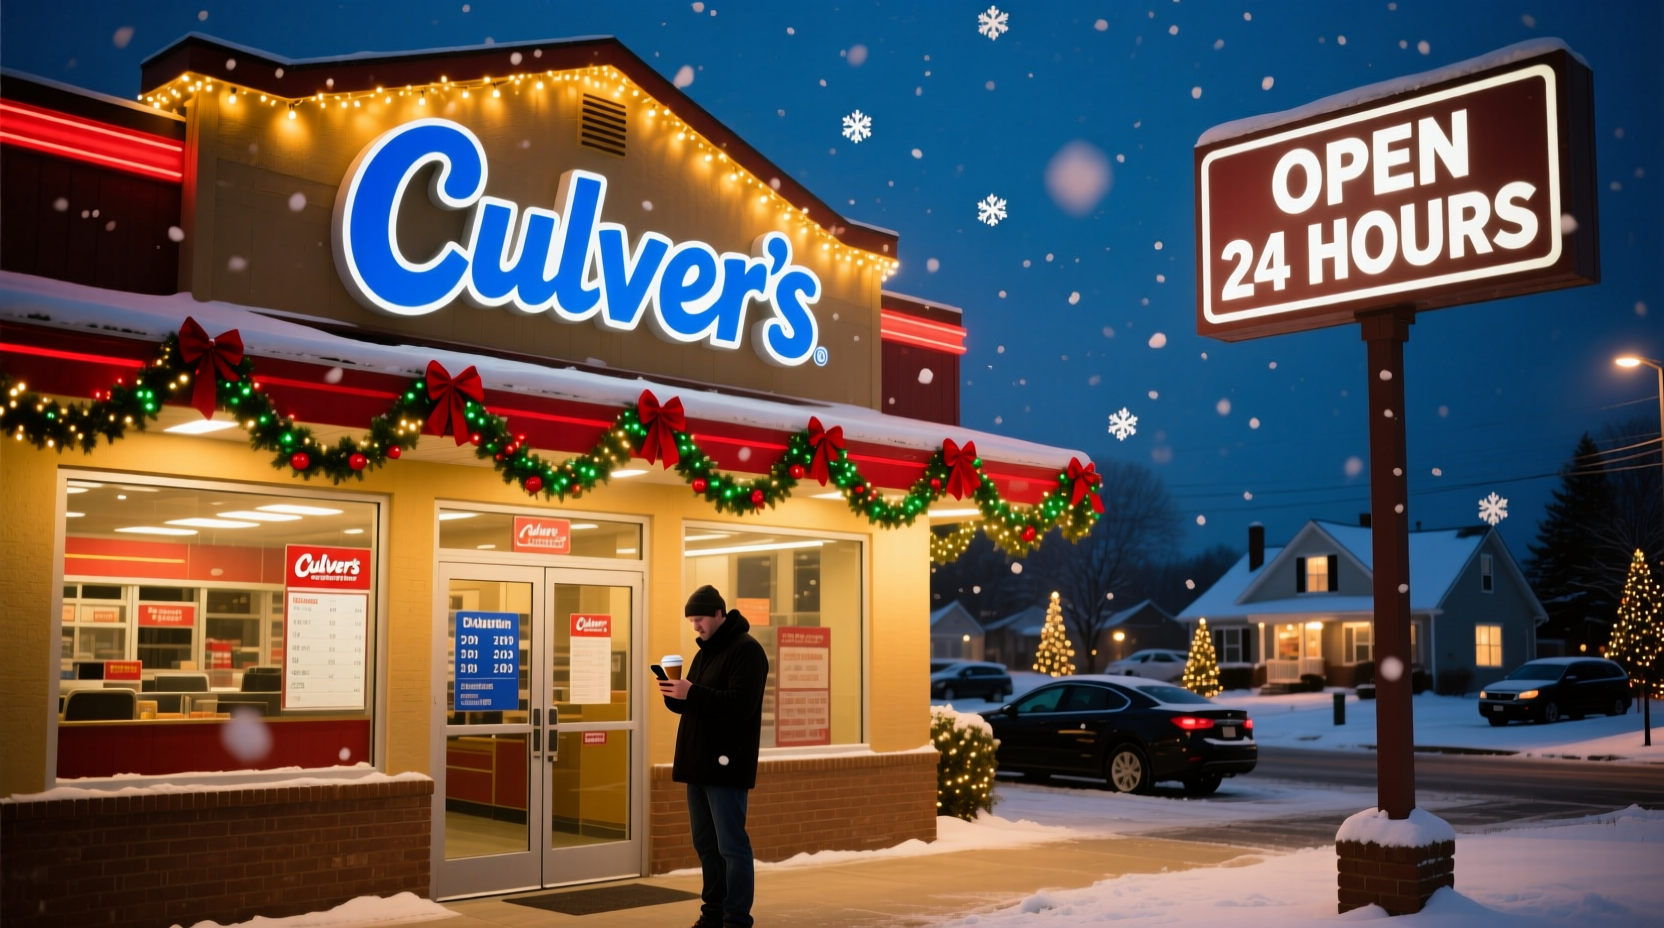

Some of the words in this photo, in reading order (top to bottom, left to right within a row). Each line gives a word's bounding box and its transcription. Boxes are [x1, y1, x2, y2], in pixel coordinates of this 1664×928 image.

[1272, 108, 1469, 215] OPEN
[342, 117, 822, 366] Culver's
[1220, 231, 1291, 301] 24
[1307, 181, 1539, 286] HOURS
[294, 552, 361, 578] Culver's
